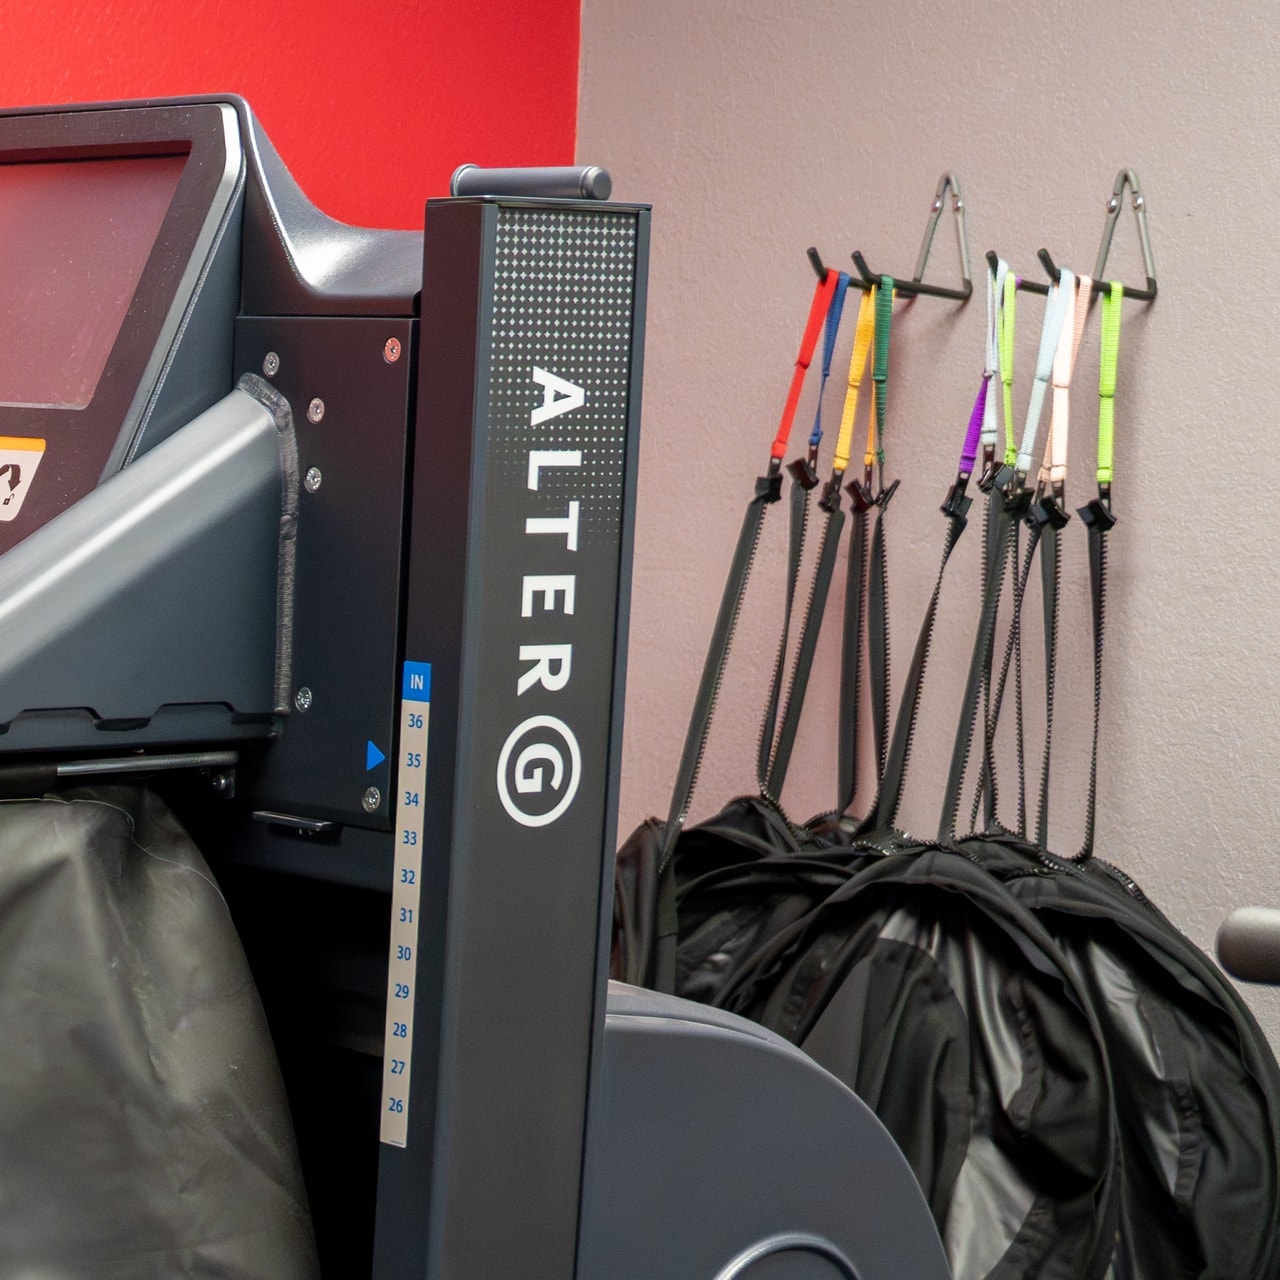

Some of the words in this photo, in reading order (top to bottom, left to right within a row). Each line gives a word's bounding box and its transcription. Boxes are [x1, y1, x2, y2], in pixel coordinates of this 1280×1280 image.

[410, 674, 424, 691] IN
[407, 713, 423, 729] 36
[406, 753, 421, 768] 35
[404, 792, 419, 807] 34
[402, 830, 417, 846] 33
[400, 869, 415, 885] 32
[399, 907, 413, 924] 31
[396, 945, 412, 961] 30
[394, 983, 409, 999] 29
[392, 1022, 408, 1038] 28
[390, 1059, 406, 1075] 27
[388, 1097, 403, 1114] 26
